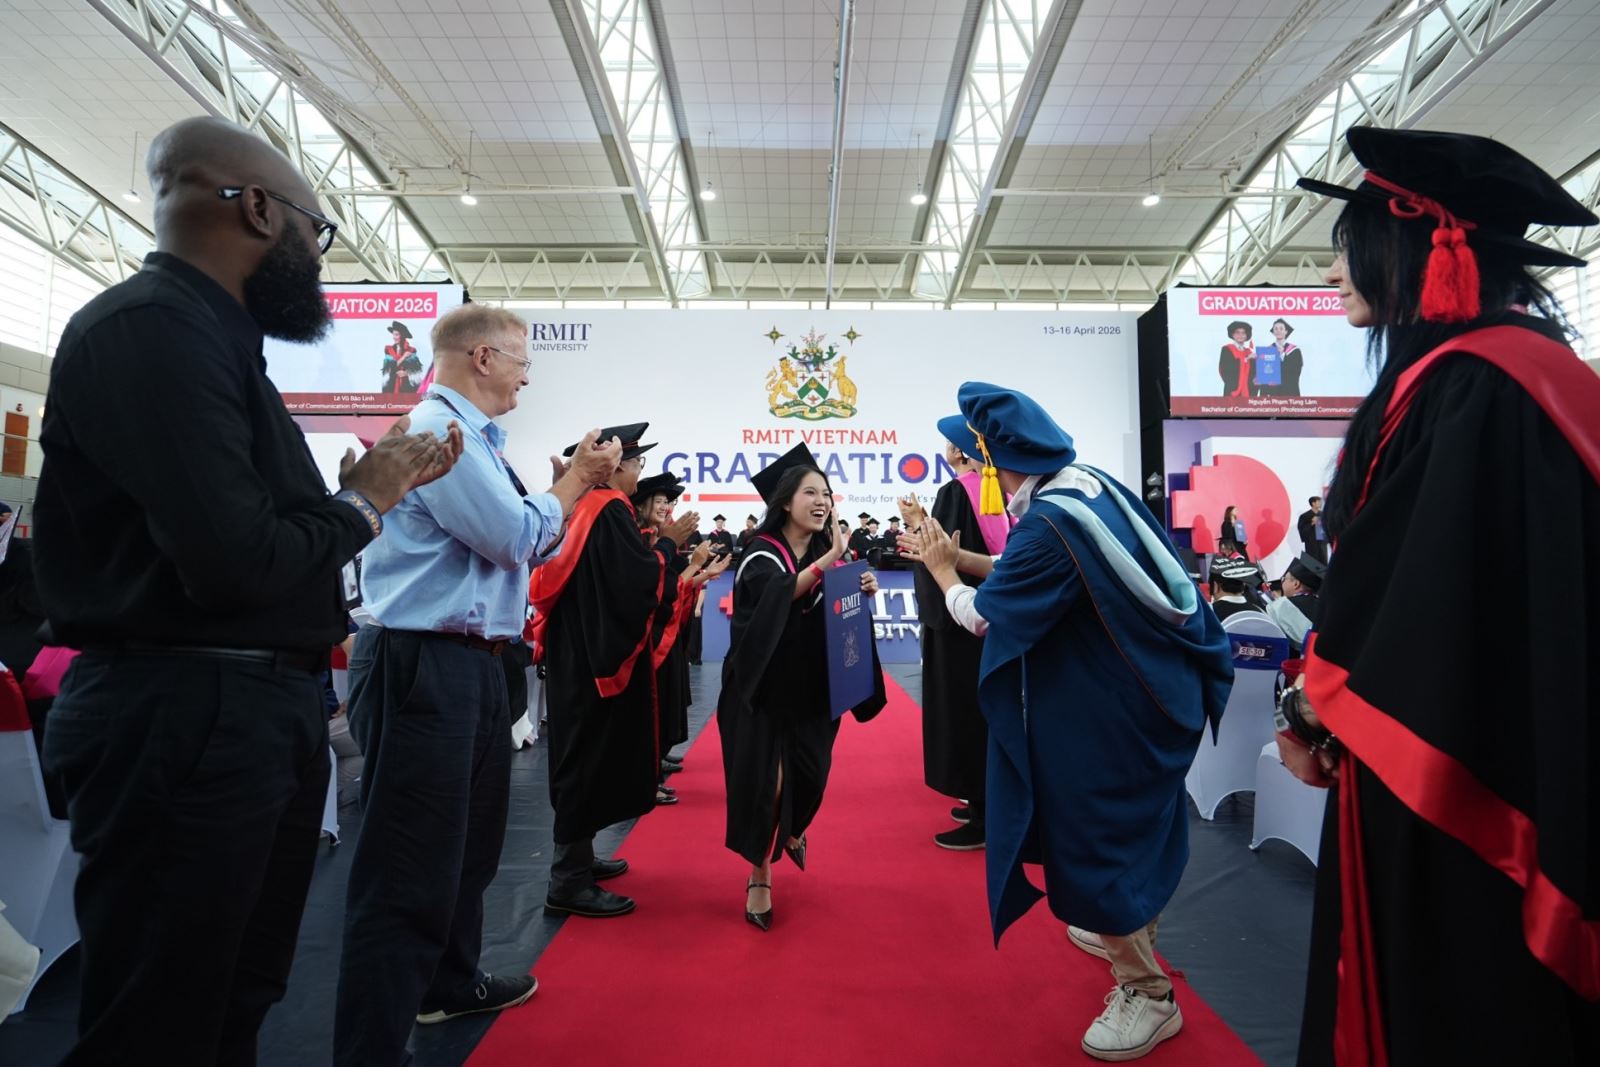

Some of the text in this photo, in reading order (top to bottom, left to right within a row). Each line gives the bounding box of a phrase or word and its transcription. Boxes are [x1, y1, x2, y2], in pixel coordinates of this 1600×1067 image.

[394, 298, 433, 313] 2026
[1201, 296, 1344, 311] GRADUATION 202
[531, 323, 592, 341] RMIT
[1073, 325, 1095, 336] April
[1097, 325, 1121, 335] 2026
[532, 343, 588, 352] UNIVERSITY
[742, 429, 898, 445] RMIT VIETNAM
[662, 452, 958, 484] GRAATION
[848, 494, 878, 505] Ready
[880, 494, 894, 502] for
[841, 592, 861, 612] RMIT
